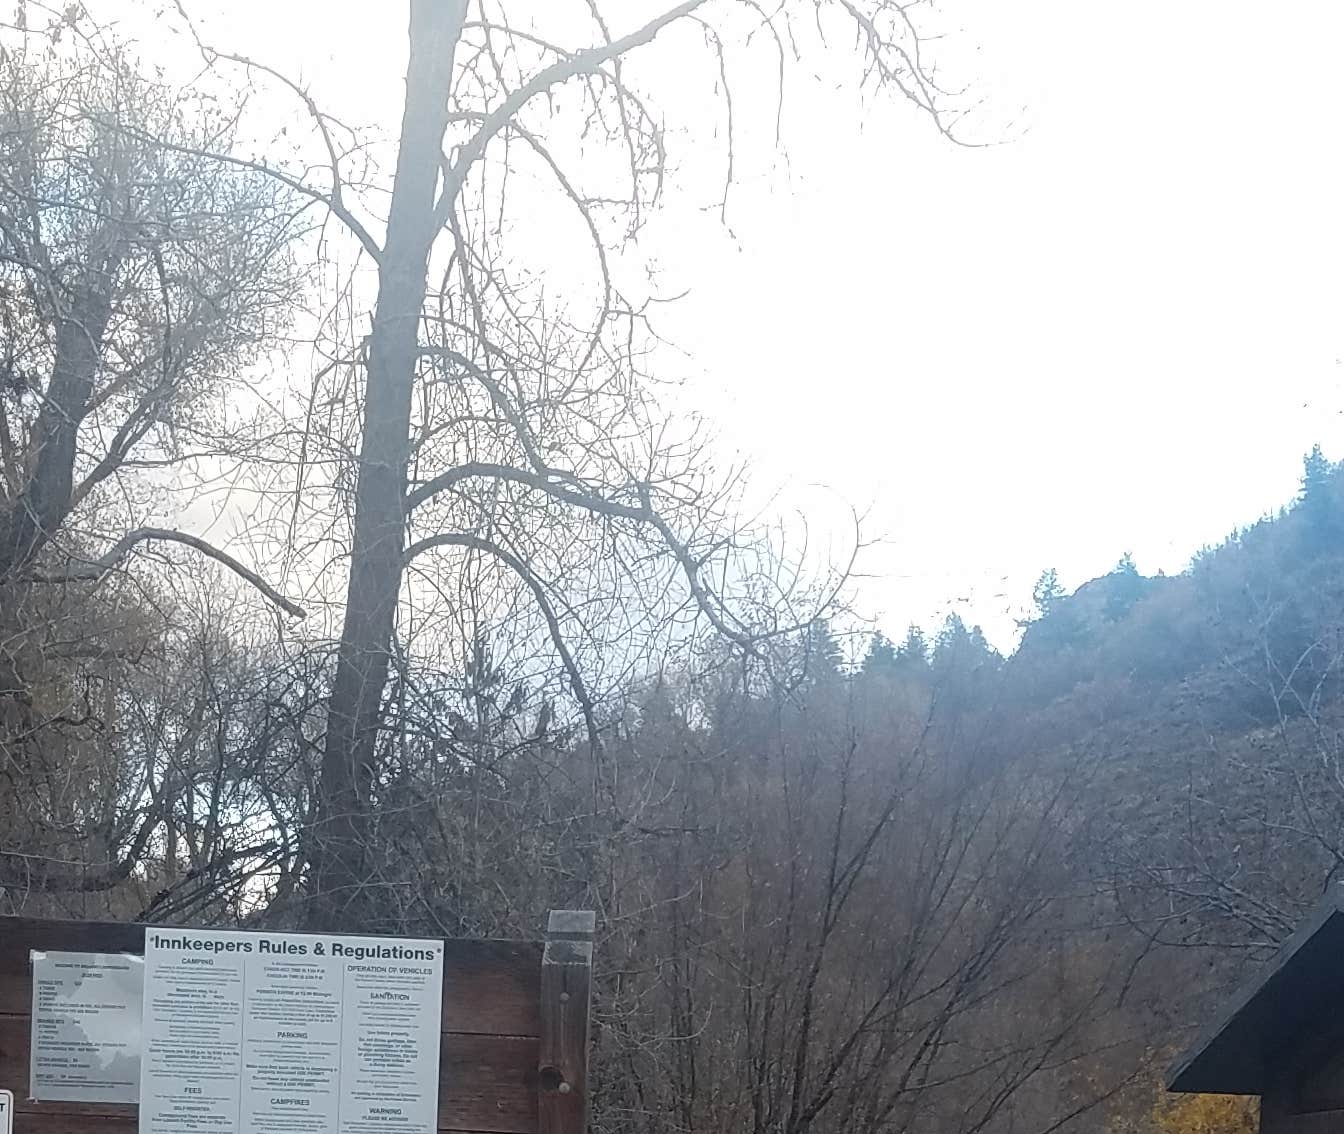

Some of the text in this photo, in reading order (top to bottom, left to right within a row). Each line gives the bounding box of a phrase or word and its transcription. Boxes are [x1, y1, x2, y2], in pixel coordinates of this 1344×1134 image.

[155, 936, 434, 960] Innkeepers Rules & Regulations
[348, 965, 386, 973] OPERATION
[271, 1098, 310, 1106] CAMPFIRES
